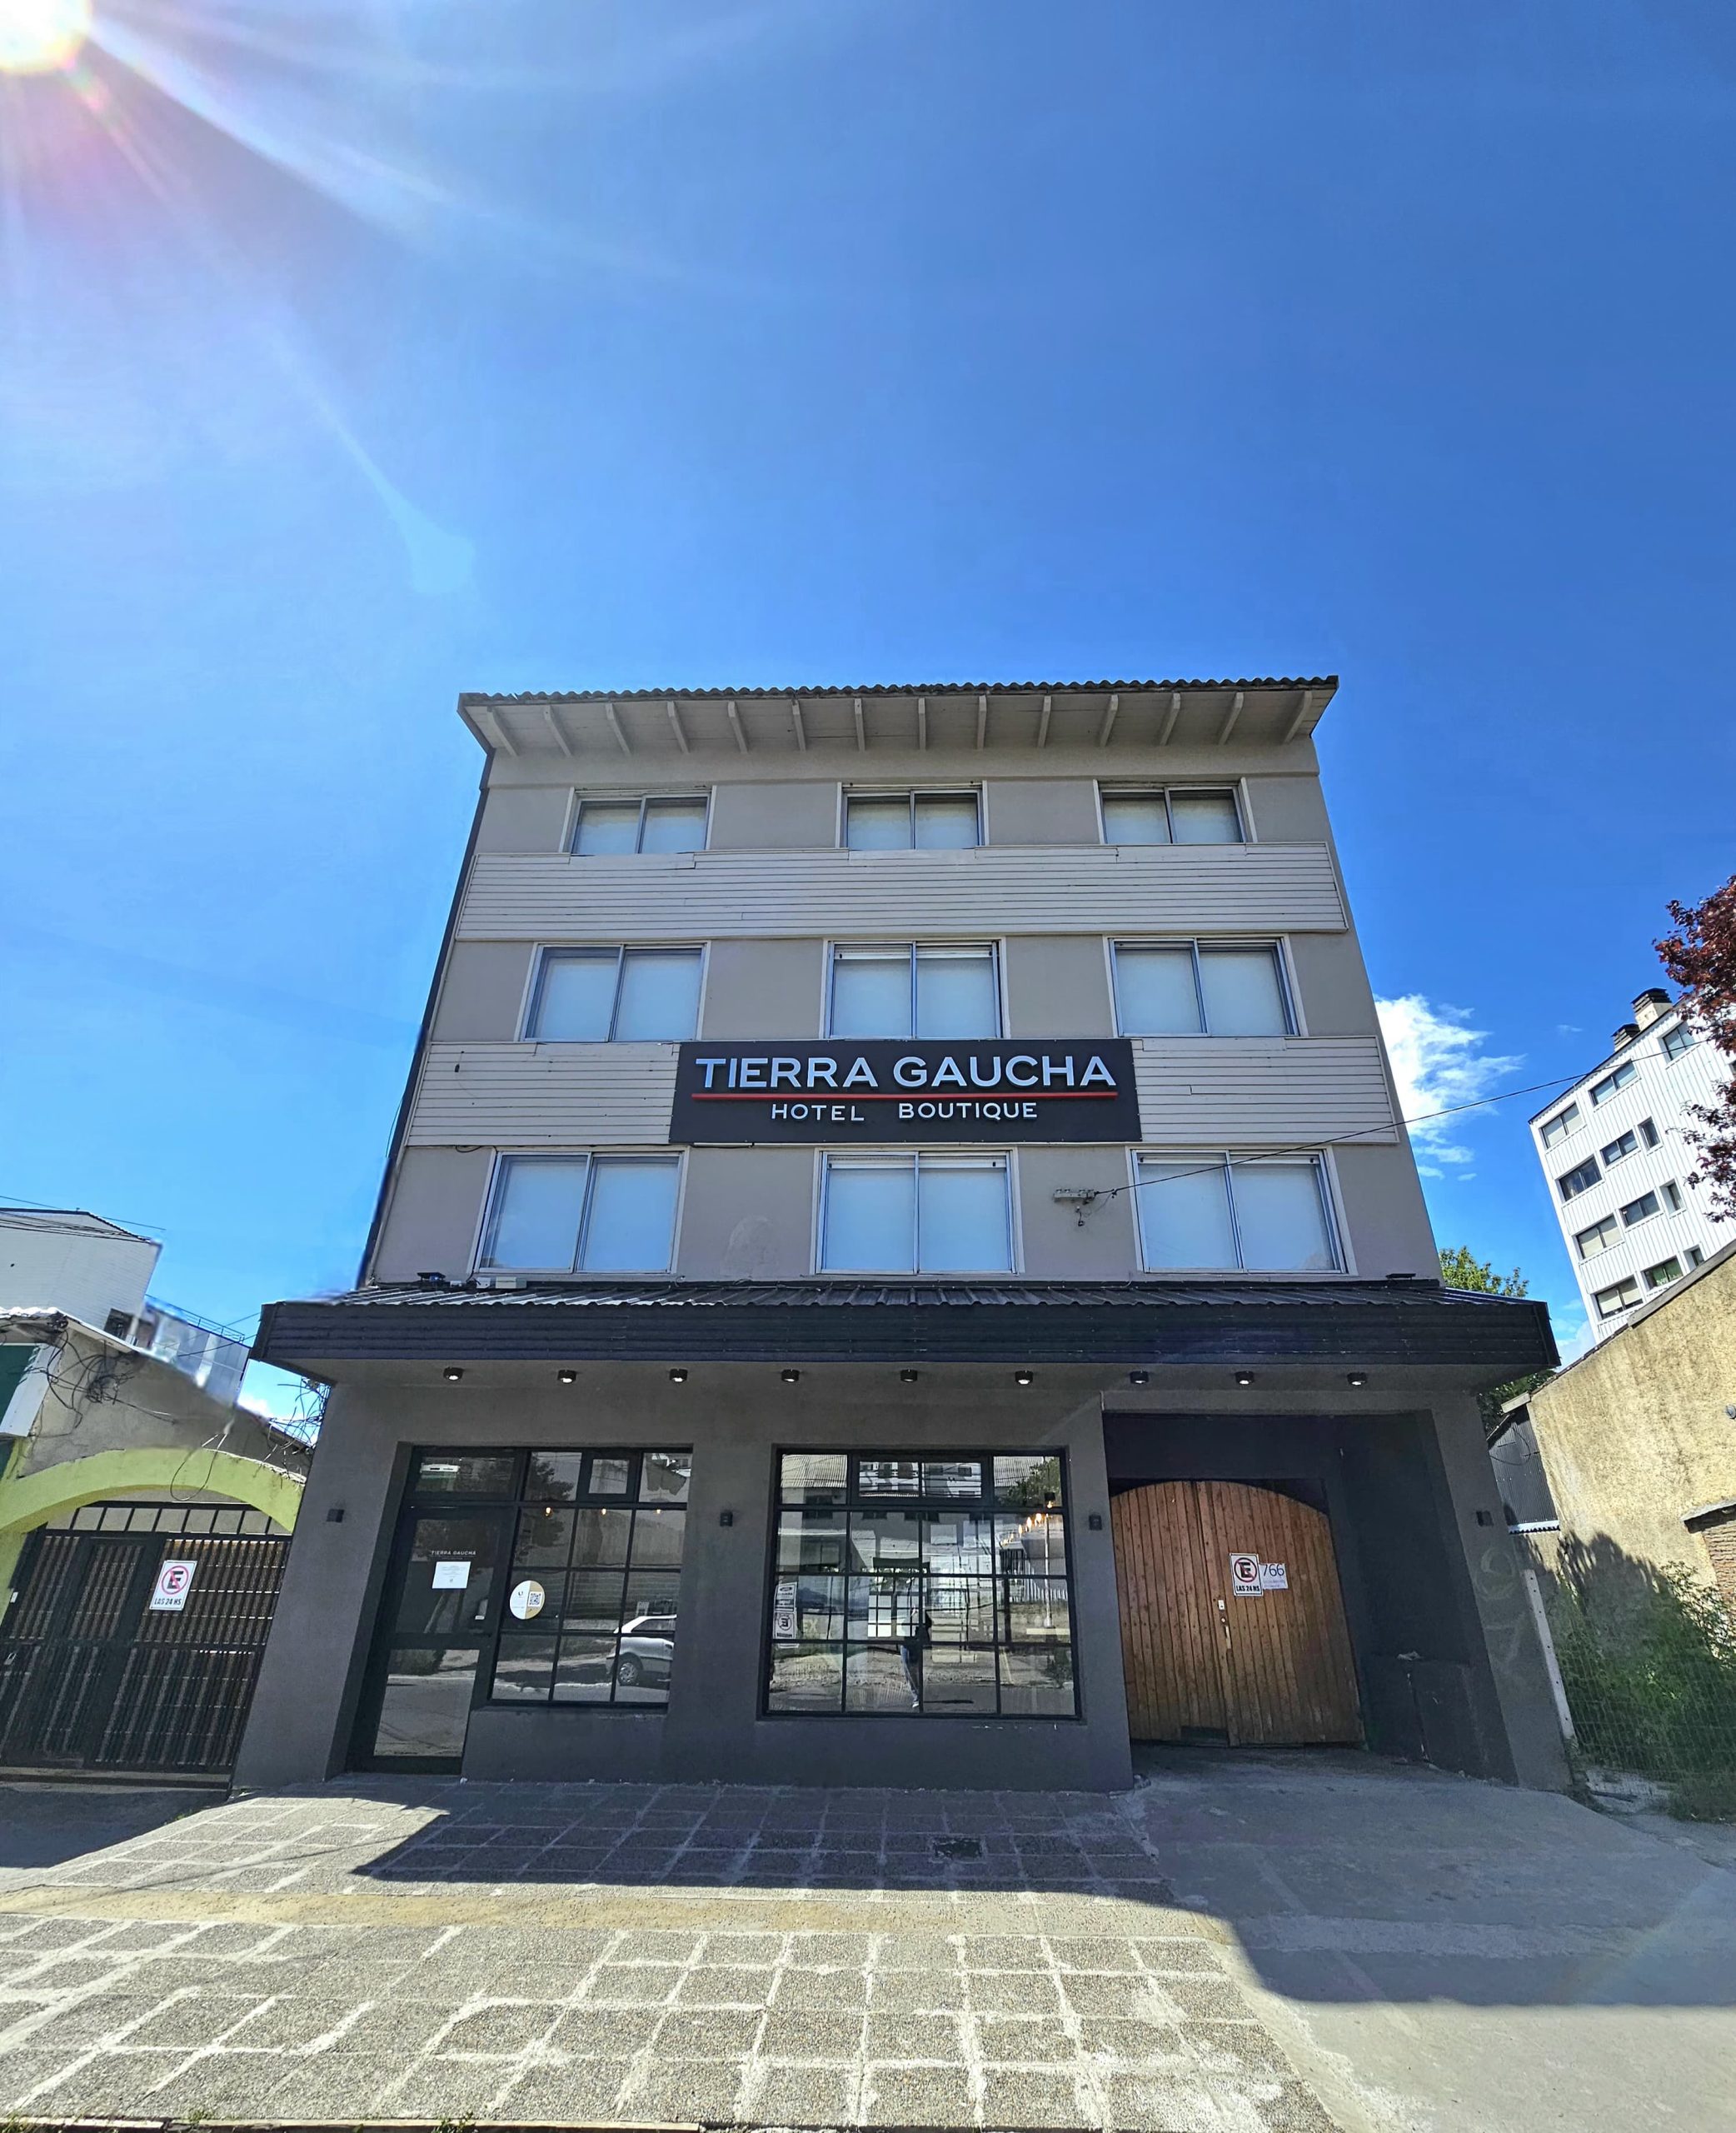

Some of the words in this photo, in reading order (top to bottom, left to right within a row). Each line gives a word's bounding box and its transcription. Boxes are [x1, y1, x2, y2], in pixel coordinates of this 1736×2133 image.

[696, 1057, 879, 1088] TIERRA
[893, 1055, 1117, 1087] GAUCHA
[771, 1103, 865, 1121] HOTEL
[899, 1101, 1038, 1121] BOUTIQUE
